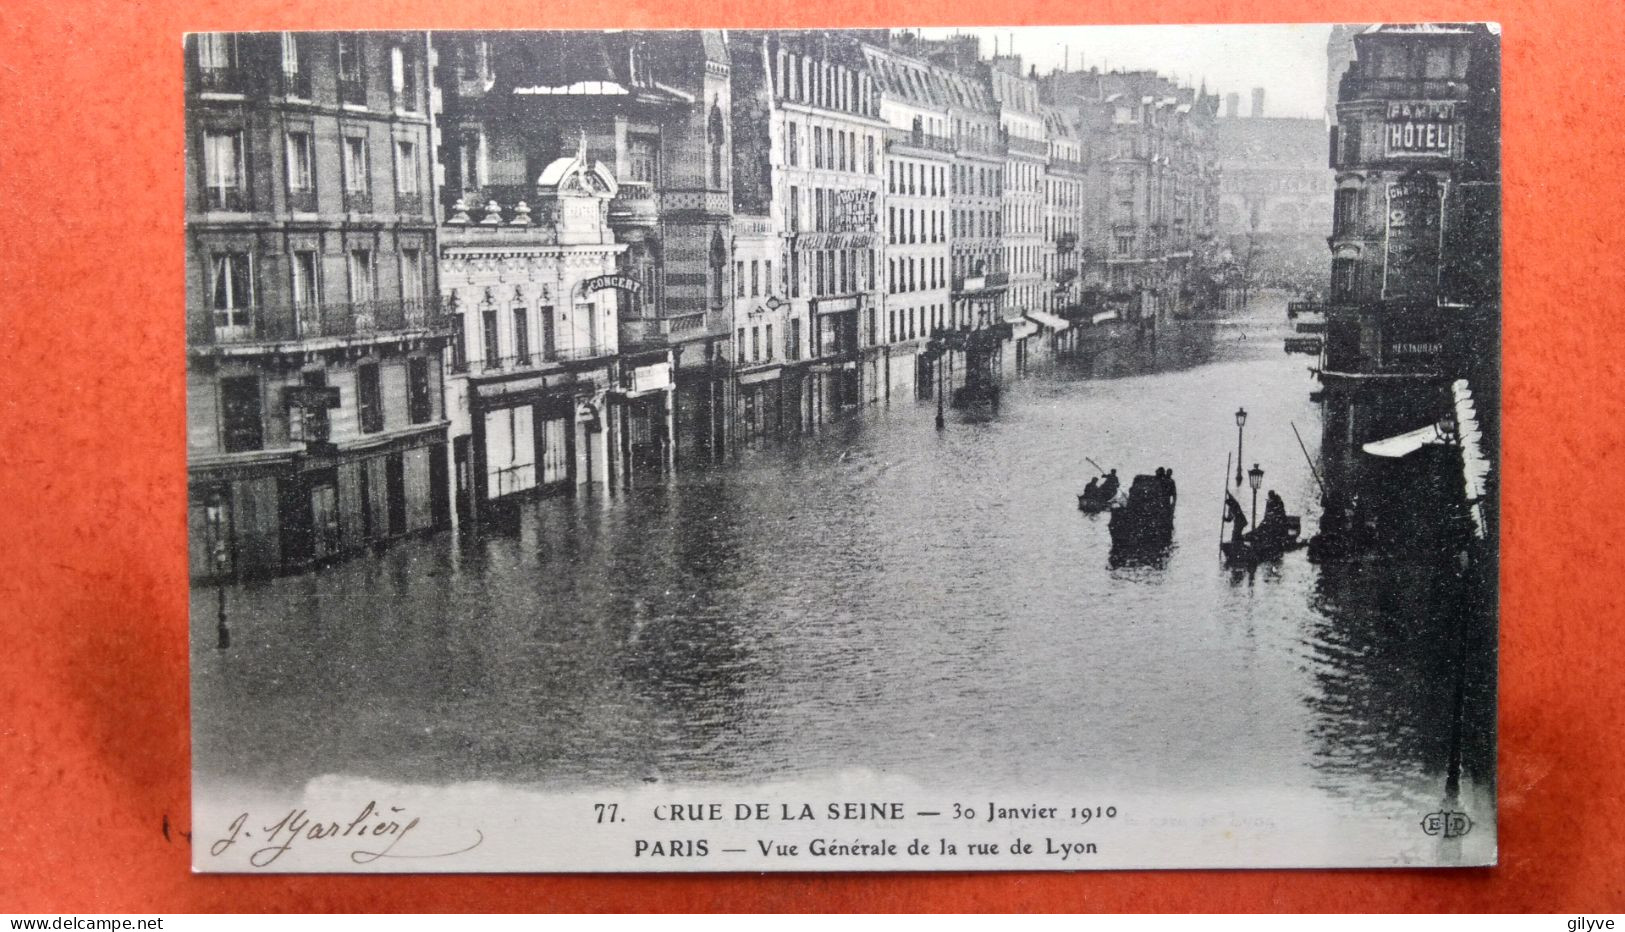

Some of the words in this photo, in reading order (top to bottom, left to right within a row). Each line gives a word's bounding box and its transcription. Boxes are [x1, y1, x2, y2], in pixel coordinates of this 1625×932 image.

[1391, 121, 1447, 148] HÔTEL
[590, 277, 641, 293] CONCERT
[595, 803, 625, 824] 77.
[653, 804, 724, 821] CRUE
[735, 804, 770, 821] DE
[781, 803, 815, 821] LA
[827, 802, 905, 820] SEINE
[953, 803, 976, 820] 30
[987, 802, 1057, 823] Janvier
[1071, 806, 1118, 824] 1910
[635, 839, 709, 857] PARIS
[758, 839, 799, 857] Vue
[808, 837, 897, 857] Générale
[907, 838, 930, 857] de
[940, 838, 957, 857] la
[967, 843, 999, 856] rue
[1010, 838, 1033, 856] de
[1046, 837, 1097, 861] Lyon
